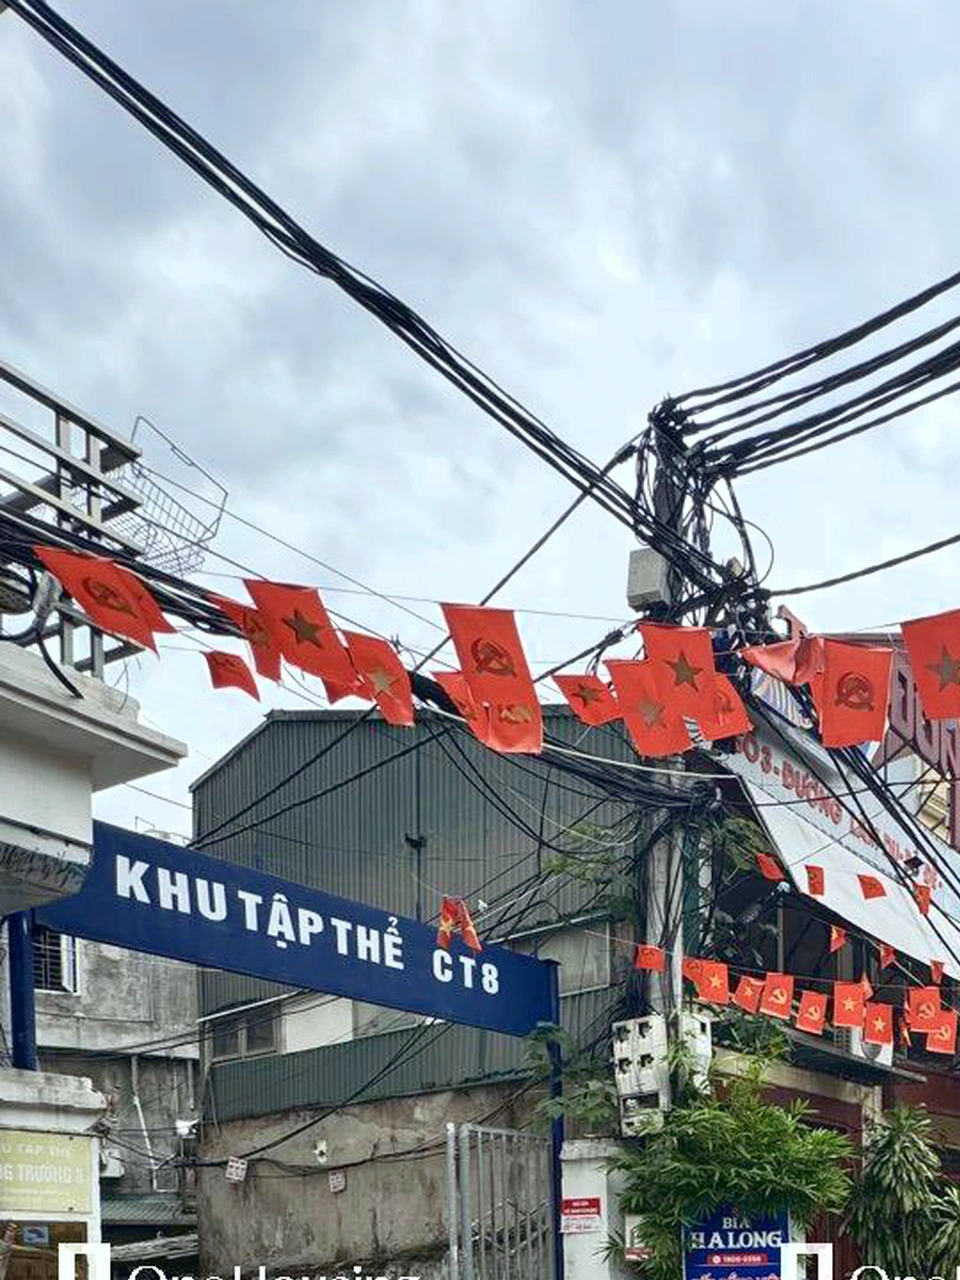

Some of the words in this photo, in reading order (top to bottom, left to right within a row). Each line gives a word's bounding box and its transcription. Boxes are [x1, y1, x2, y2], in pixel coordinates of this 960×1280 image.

[116, 854, 228, 922] KHU
[237, 890, 324, 950] TẬP
[330, 915, 405, 971] THỂ
[432, 948, 499, 995] CT8
